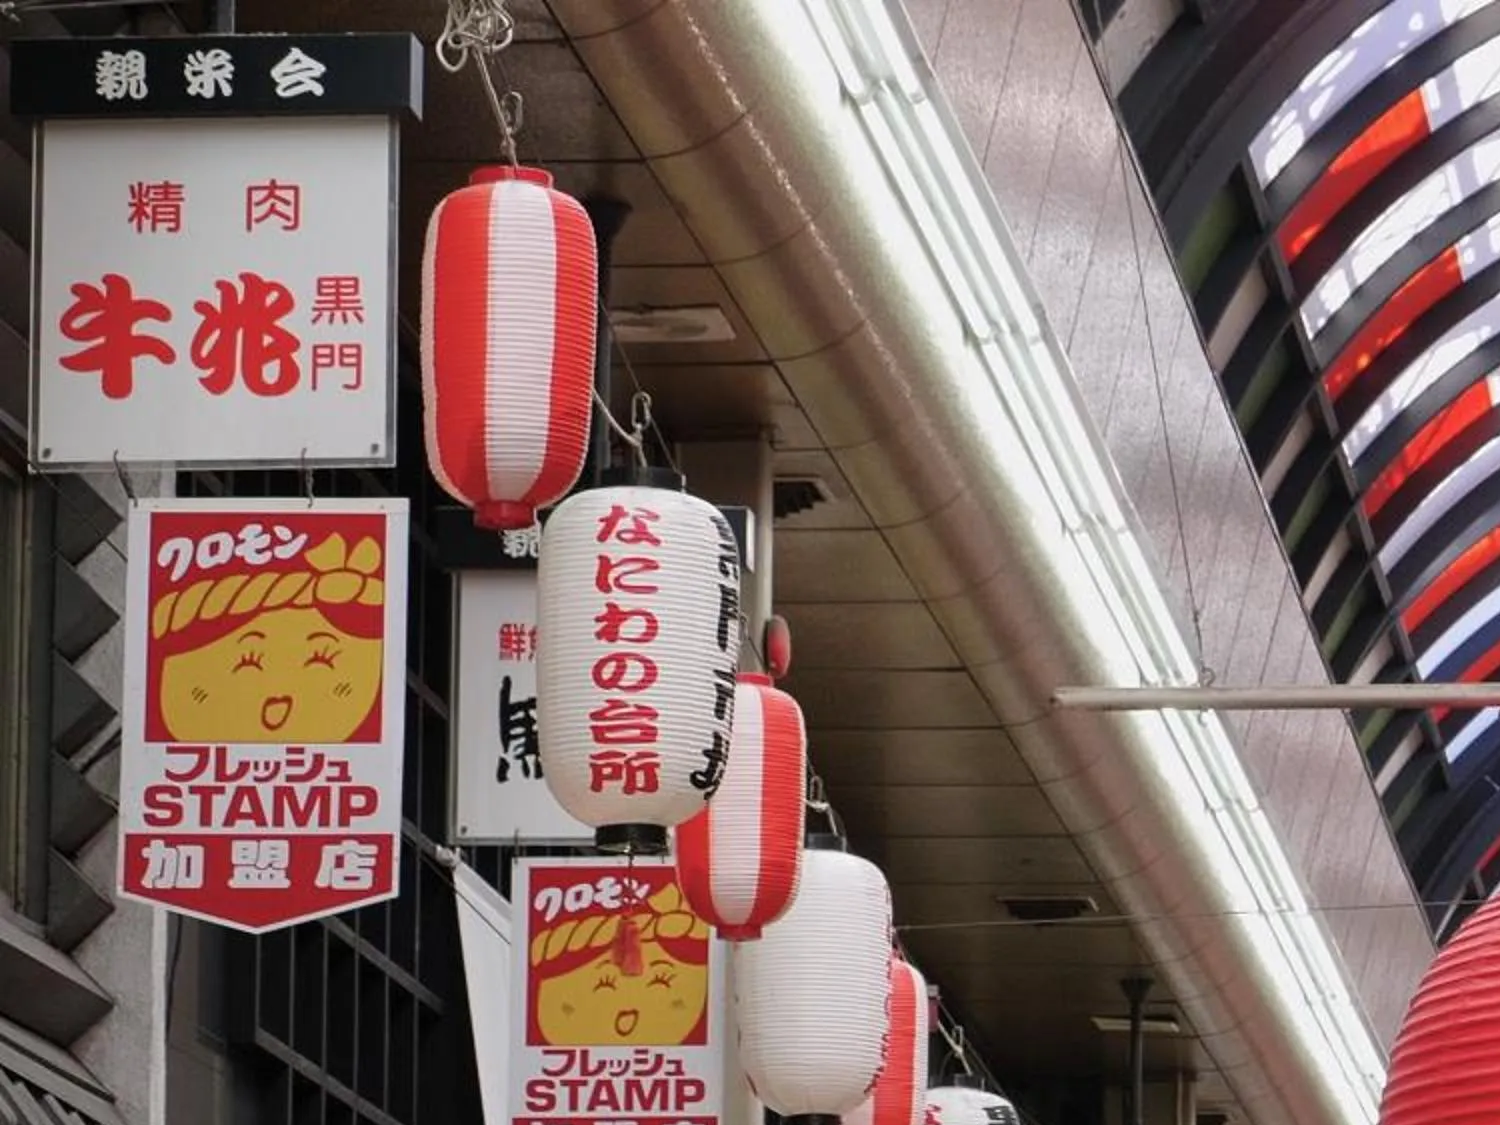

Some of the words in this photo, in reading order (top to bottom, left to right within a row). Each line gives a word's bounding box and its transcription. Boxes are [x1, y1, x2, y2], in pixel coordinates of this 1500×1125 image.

[95, 48, 327, 101] 親栄会
[127, 179, 302, 234] 精肉
[310, 276, 365, 391] 黒門
[157, 523, 310, 582] クロモン
[589, 503, 662, 796] なにわの台所
[164, 747, 353, 784] フレッシュ
[142, 786, 379, 829] STAMP
[140, 839, 378, 891] 加盟店
[541, 1049, 685, 1077] フレッシュ
[525, 1078, 706, 1112] STAMP
